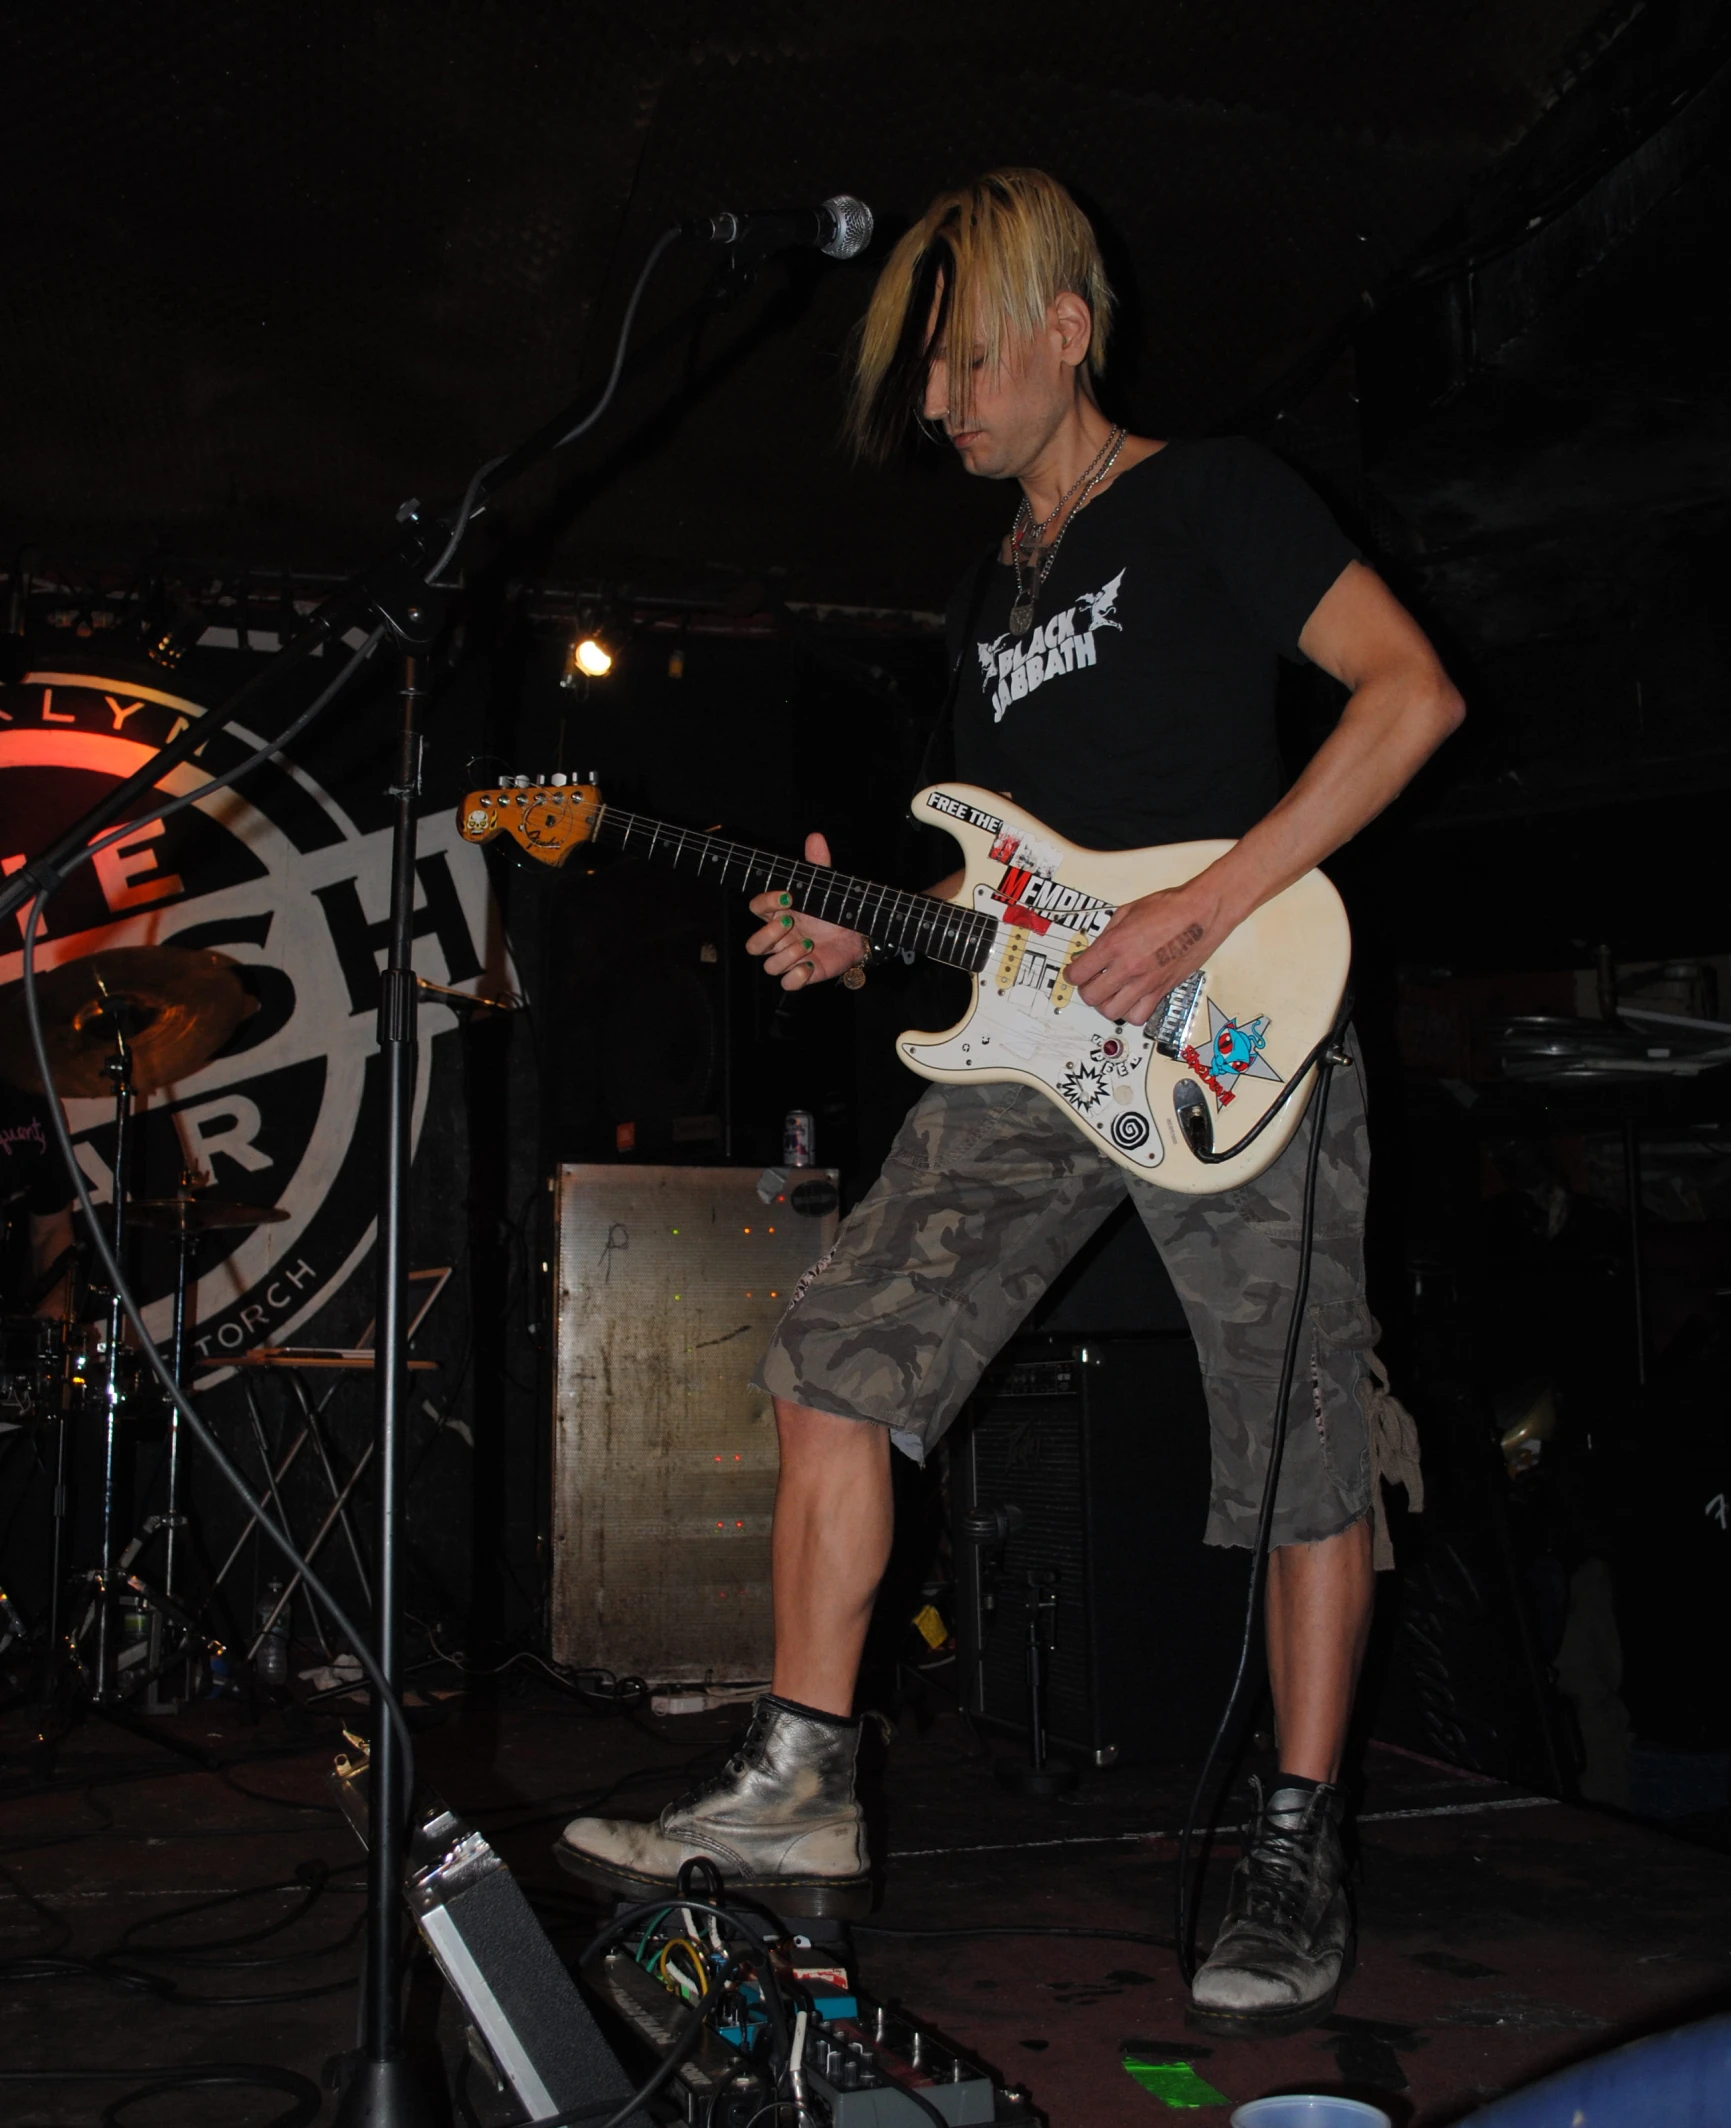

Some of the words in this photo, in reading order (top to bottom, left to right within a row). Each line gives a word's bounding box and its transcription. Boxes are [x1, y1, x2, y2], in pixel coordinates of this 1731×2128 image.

[991, 631, 1097, 724] SABBATH
[997, 606, 1077, 681] BLACK
[927, 793, 969, 819] FREE
[968, 809, 1000, 833] THE
[194, 1257, 317, 1357] TORCH
